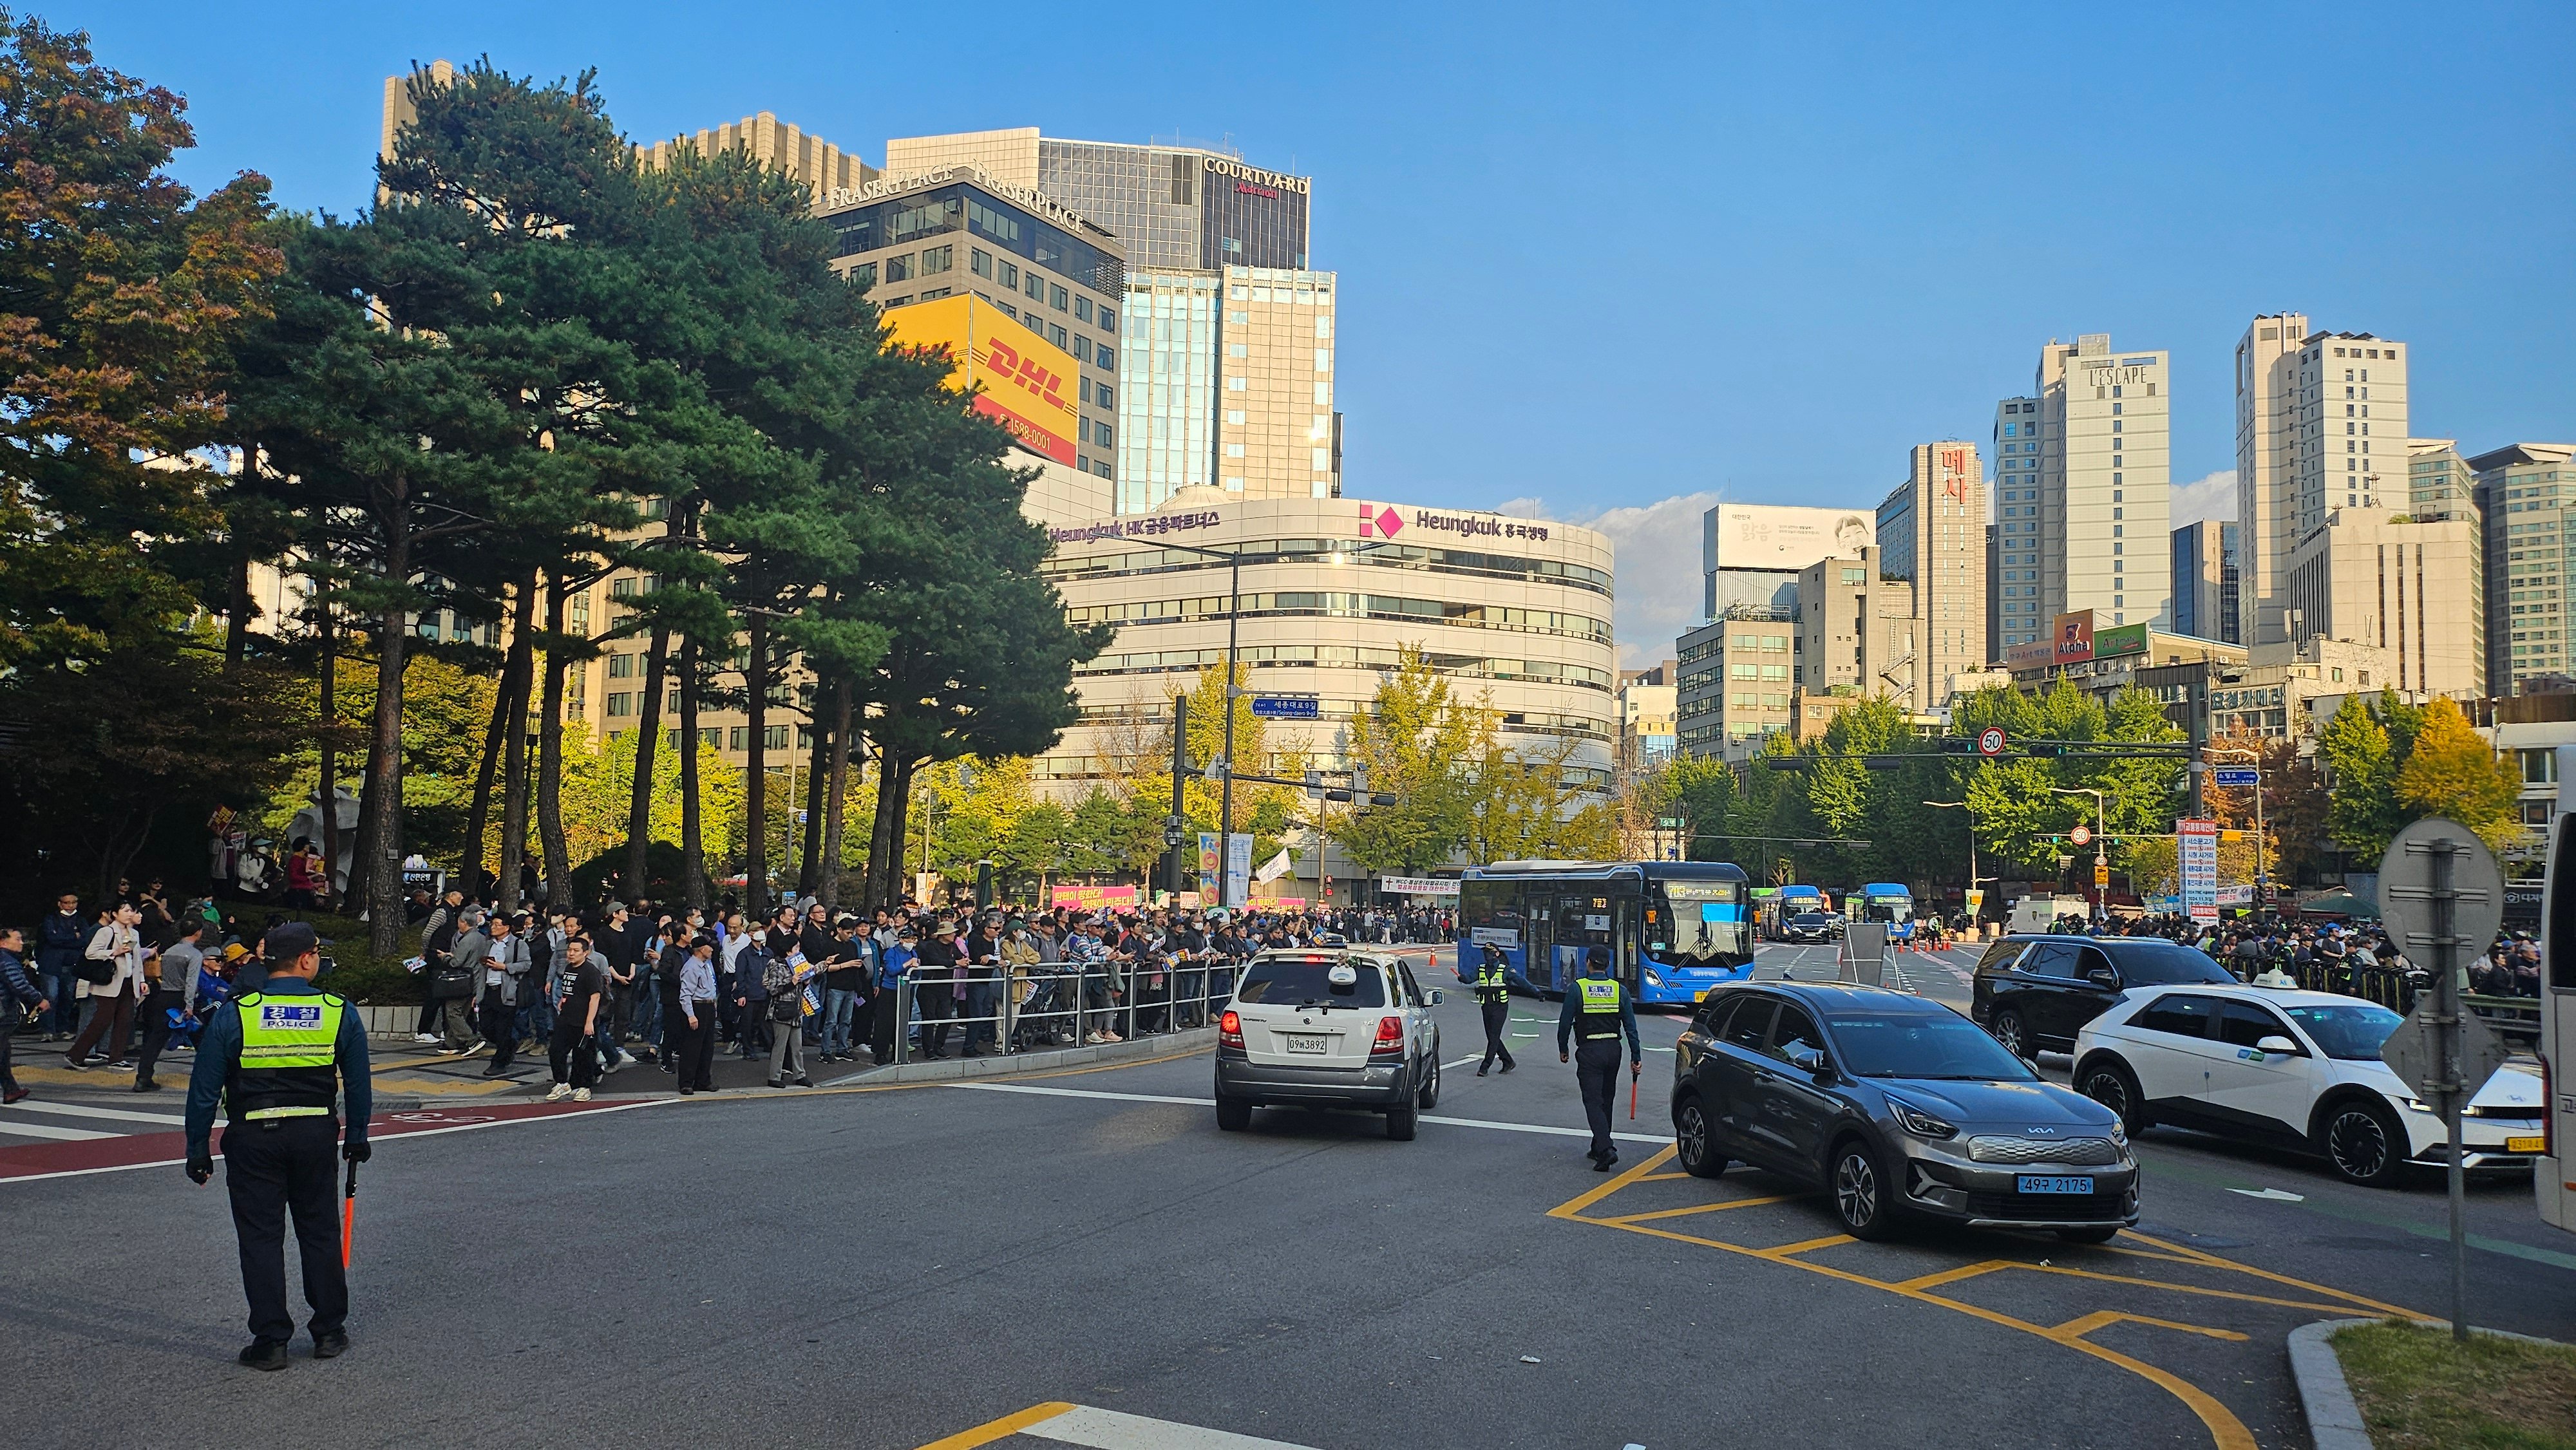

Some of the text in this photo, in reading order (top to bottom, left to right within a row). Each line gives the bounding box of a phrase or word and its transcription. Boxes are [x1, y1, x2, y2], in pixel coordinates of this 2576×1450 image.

[1204, 158, 1308, 194] COURTYARD
[987, 337, 1065, 410] DHL
[2090, 366, 2146, 386] L'ESCAPE
[1010, 419, 1050, 451] 1588-0001
[1942, 449, 1968, 504] 메사
[1050, 511, 1220, 544] Heungkuk HK 금융파트너스
[1417, 511, 1548, 541] Heungkuk 흥국생명
[2058, 639, 2090, 655] Alpha
[1274, 701, 1316, 710] 세종대로9길
[2211, 687, 2284, 710] 효성카메라
[1984, 735, 2000, 748] 50
[2056, 1179, 2087, 1192] 2175
